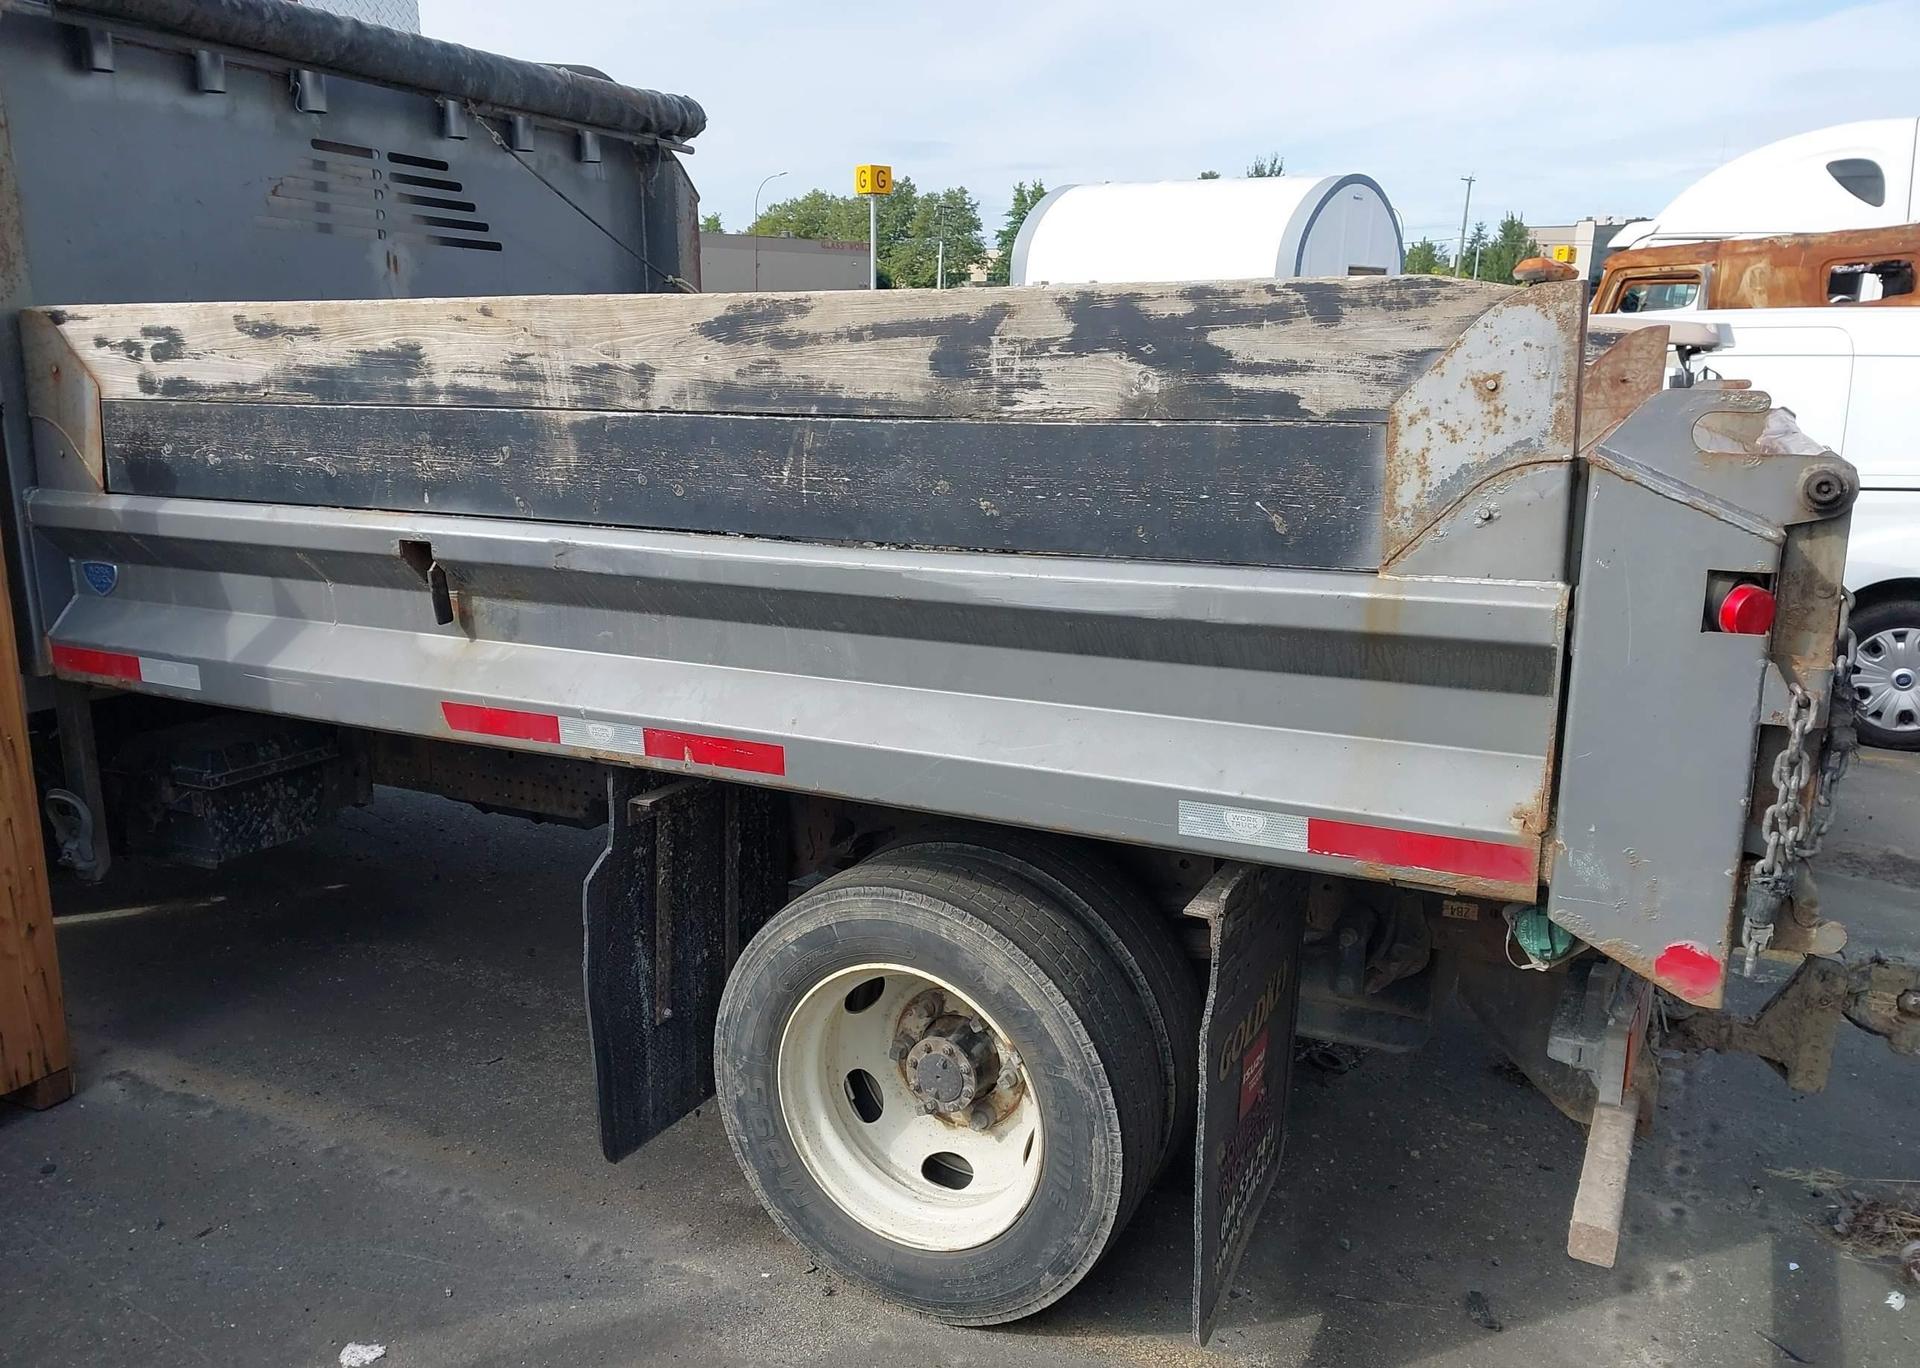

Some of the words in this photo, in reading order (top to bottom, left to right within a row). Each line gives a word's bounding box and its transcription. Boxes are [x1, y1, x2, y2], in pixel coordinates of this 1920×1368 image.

[859, 170, 867, 188] G
[876, 170, 887, 188] G
[1557, 249, 1563, 260] F
[1231, 814, 1259, 823] WORK
[1232, 821, 1258, 829] TRUCK
[1242, 1047, 1266, 1084] ISUZU
